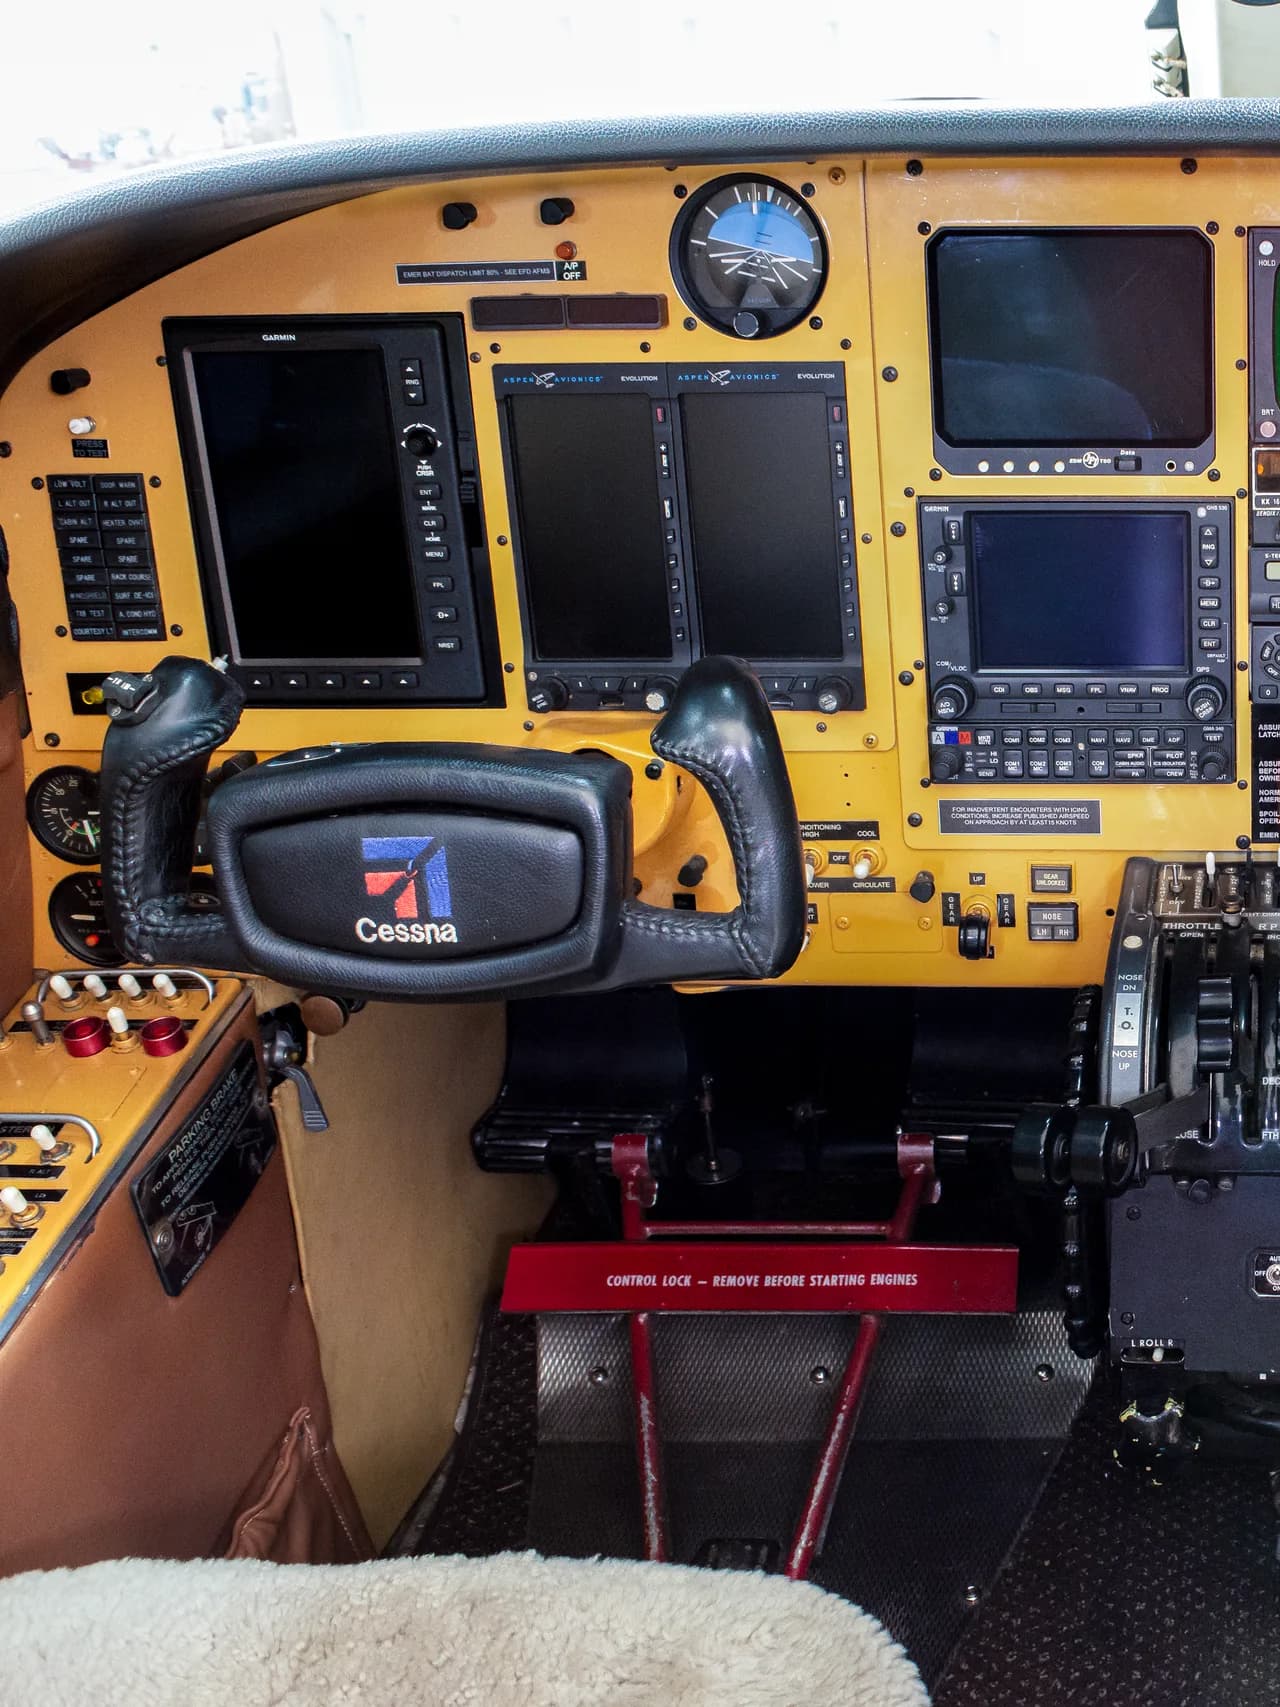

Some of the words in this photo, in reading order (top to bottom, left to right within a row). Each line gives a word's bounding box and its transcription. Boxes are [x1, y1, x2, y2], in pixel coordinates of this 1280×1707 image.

[563, 262, 578, 271] A/P
[1258, 259, 1276, 267] HOLD
[563, 271, 582, 280] OFF
[1261, 408, 1275, 416] BRT
[857, 830, 877, 838] COOL
[1042, 912, 1062, 920] NOSE
[355, 917, 458, 944] Cessna
[1162, 922, 1222, 931] THROTTLE
[1036, 928, 1047, 936] LH
[1118, 974, 1143, 982] NOSE
[1112, 1050, 1138, 1058] NOSE
[1118, 1061, 1130, 1070] UP
[1262, 1077, 1280, 1085] DEC
[168, 1108, 212, 1163] PARKING
[210, 1068, 238, 1111] BRAKE
[1261, 1131, 1280, 1140] FTH
[606, 1274, 657, 1287] CONTROL
[662, 1274, 692, 1287] LOCK
[712, 1274, 760, 1287] REMOVE
[764, 1274, 805, 1287] BEFORE
[809, 1274, 866, 1286] STARTING
[870, 1273, 918, 1286] ENGINES
[1139, 1339, 1165, 1348] ROLL
